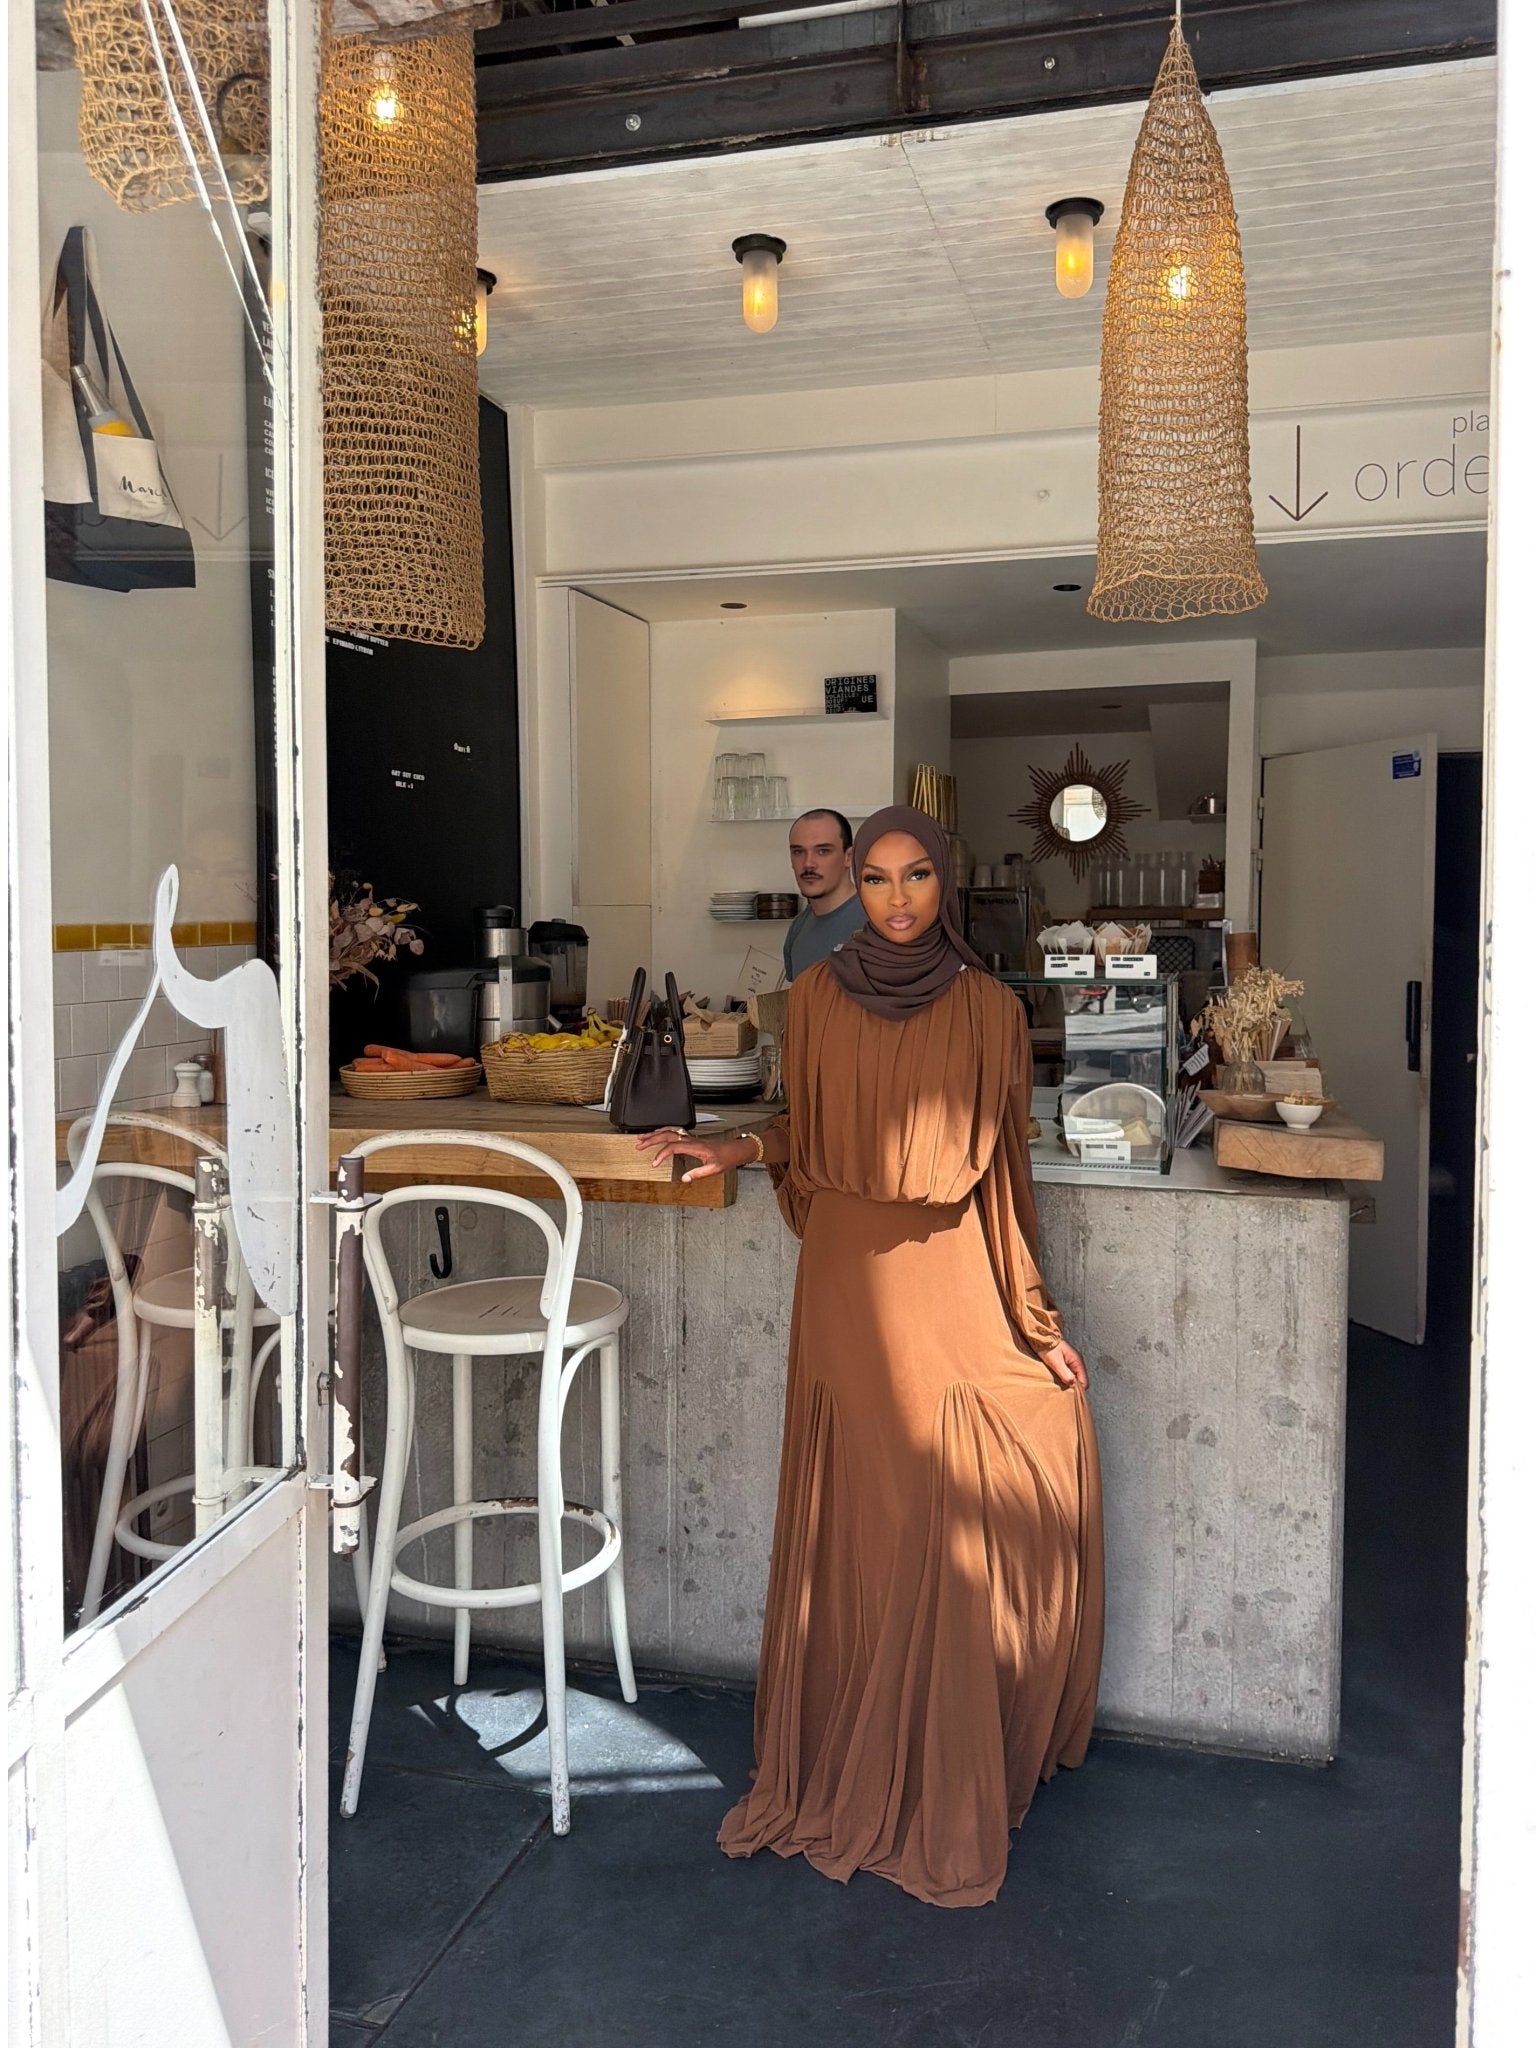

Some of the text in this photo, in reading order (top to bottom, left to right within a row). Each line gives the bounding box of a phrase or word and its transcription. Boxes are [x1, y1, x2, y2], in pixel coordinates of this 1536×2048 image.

[1355, 443, 1489, 501] orde
[825, 675, 875, 686] ORIGINES
[825, 684, 869, 694] VIANDES
[861, 695, 874, 703] UE
